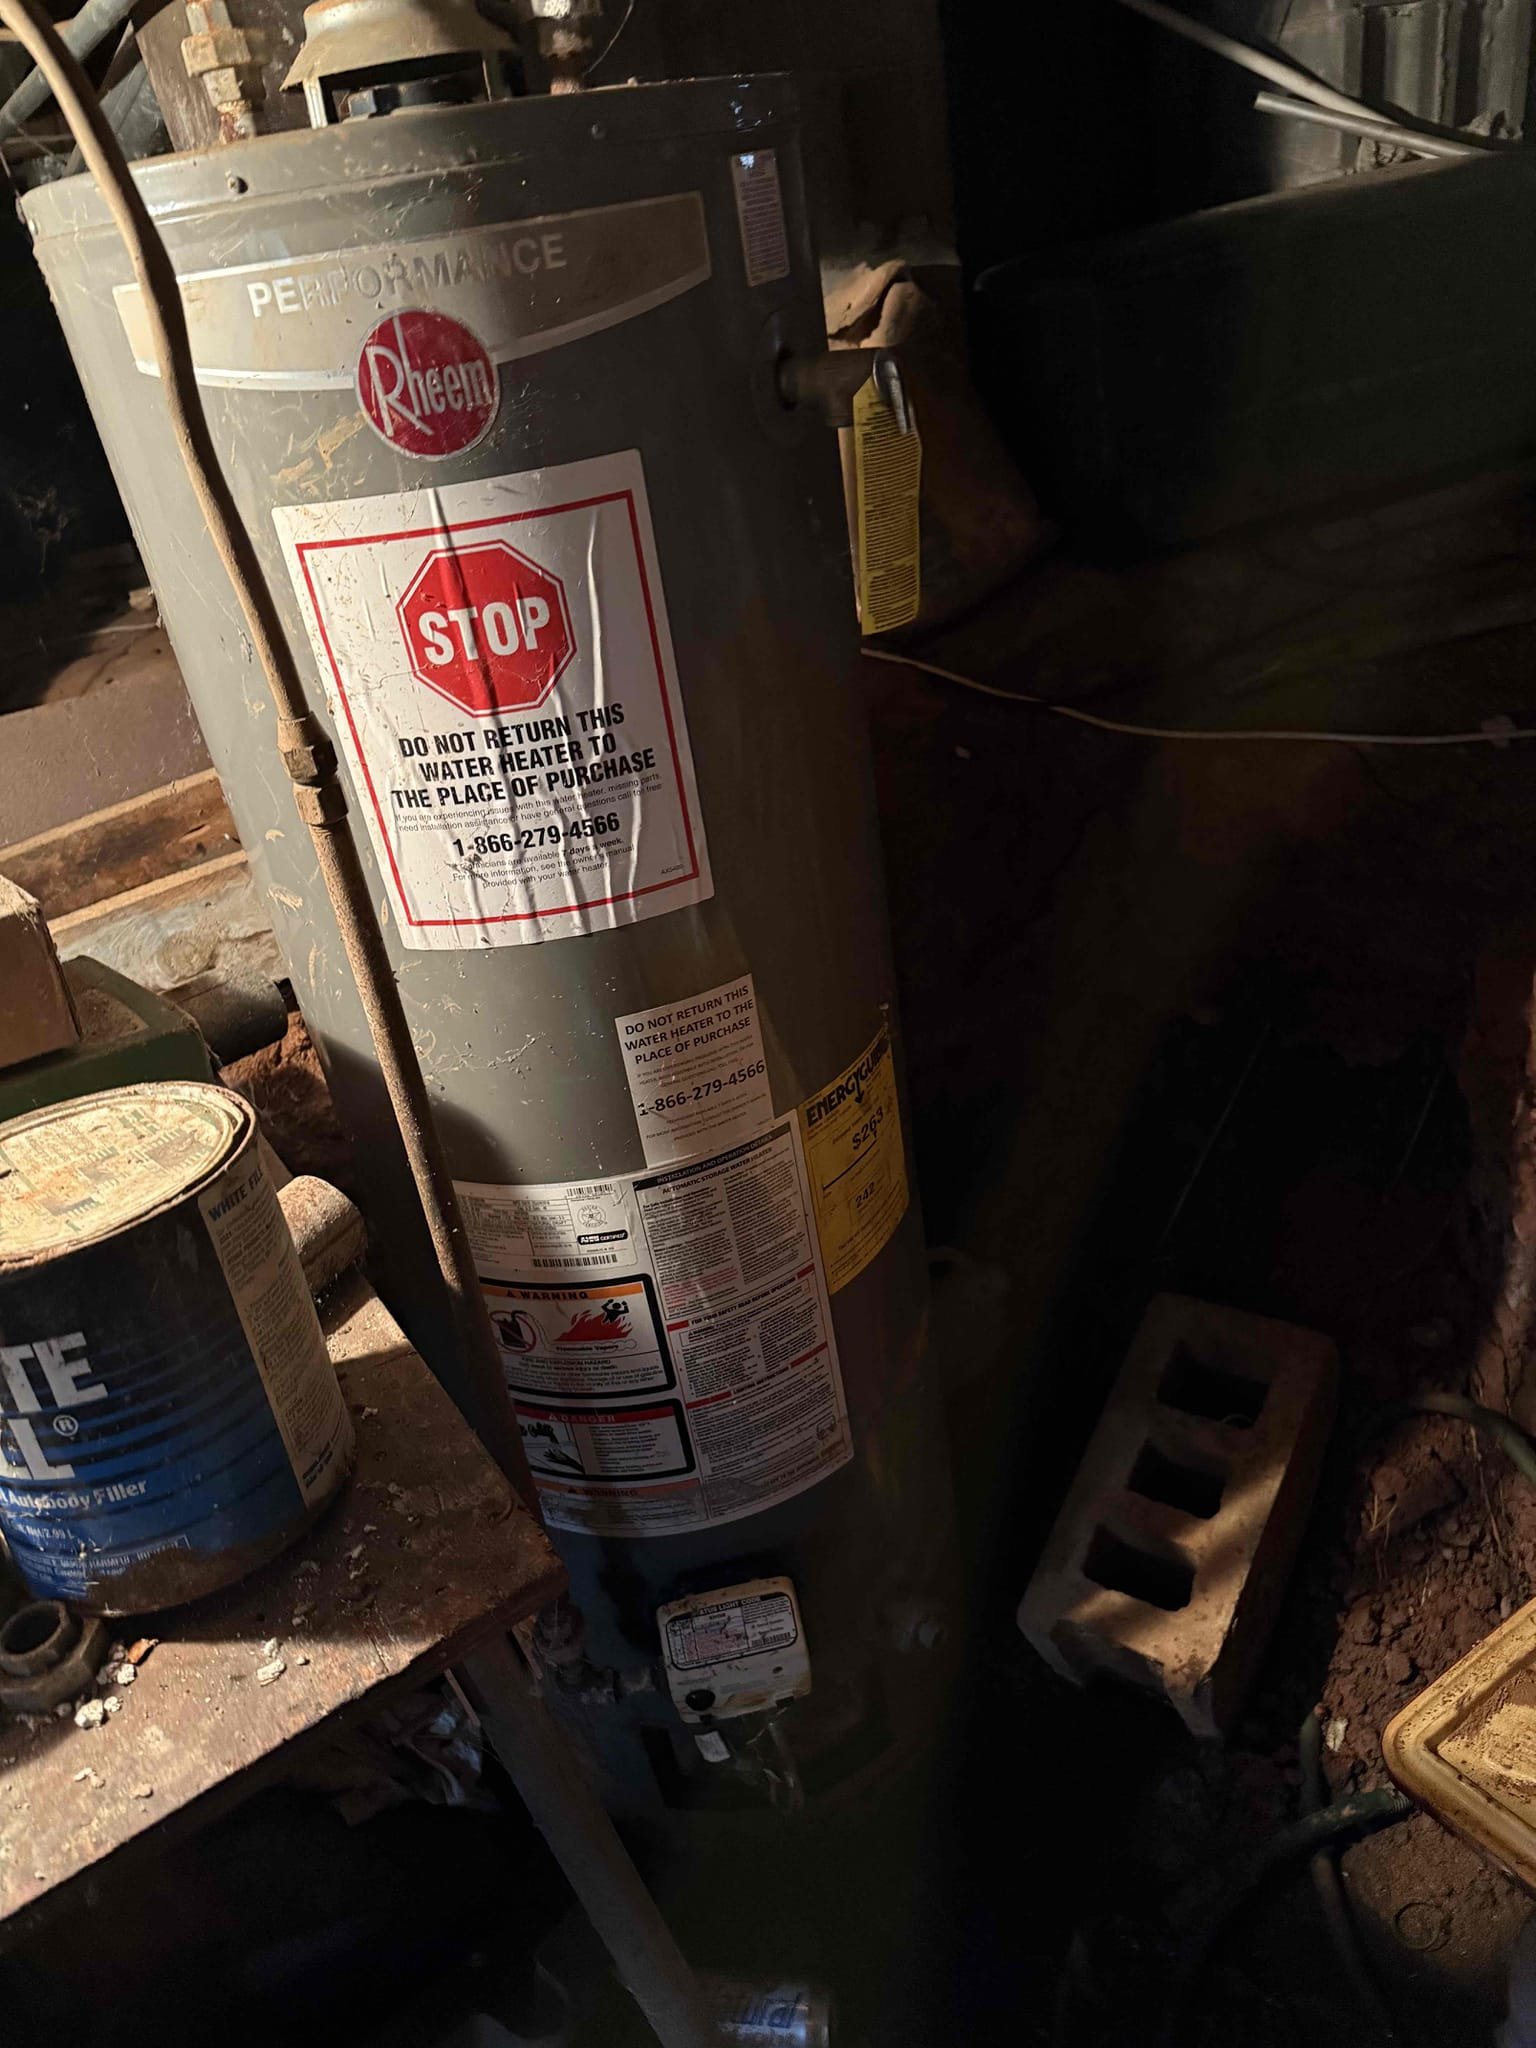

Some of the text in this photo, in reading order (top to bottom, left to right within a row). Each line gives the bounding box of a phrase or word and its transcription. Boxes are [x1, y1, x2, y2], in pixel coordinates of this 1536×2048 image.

[247, 233, 568, 318] PERFORMANCE
[364, 314, 495, 437] Rheem
[418, 596, 550, 665] STOP
[399, 703, 625, 758] DO NOT RETURN THIS
[392, 748, 656, 809] THE PLACE OF PURCHASE
[419, 732, 617, 782] WATER HEATER TO
[433, 808, 486, 823] experiencing
[516, 801, 534, 812] with
[536, 798, 551, 809] this
[608, 780, 639, 795] missing
[520, 809, 541, 820] have
[543, 803, 575, 817] general
[617, 791, 632, 801] call
[645, 783, 662, 794] free
[452, 813, 620, 857] 1-866-279-4566
[569, 845, 590, 856] days
[482, 878, 517, 889] provided
[520, 875, 536, 884] with
[538, 872, 555, 883] your
[624, 999, 754, 1051] WATER HEATER TO THE
[625, 985, 749, 1035] DO NOT RETURN THIS
[635, 1017, 751, 1064] PLACE OF PURCHASE
[637, 1060, 765, 1116] 1-866-279-4566
[806, 1042, 888, 1127] ENERGYGUI
[208, 1186, 247, 1221] WHITE
[662, 1178, 701, 1194] AUTOMATIC
[702, 1166, 729, 1182] STORAGE
[522, 1290, 589, 1301] WARNING
[0, 1332, 108, 1413] TE
[562, 1414, 616, 1424] DANGER
[93, 1481, 147, 1505] Filler
